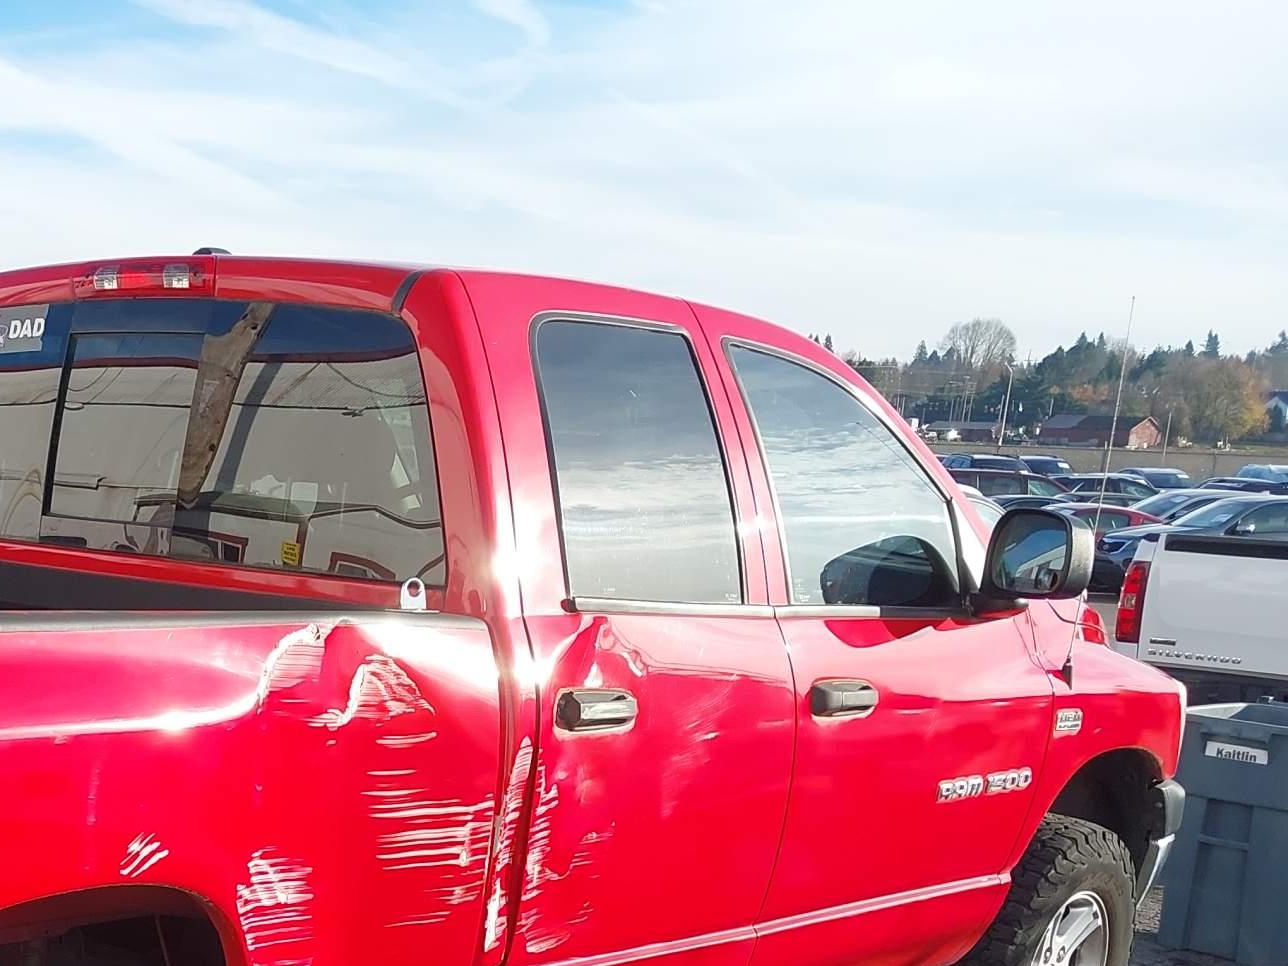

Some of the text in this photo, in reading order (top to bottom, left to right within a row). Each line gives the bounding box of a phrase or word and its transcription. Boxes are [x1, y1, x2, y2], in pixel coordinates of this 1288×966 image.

[8, 318, 45, 339] DAD
[1148, 648, 1242, 665] SILVERADO
[1216, 747, 1257, 763] Kaitlin
[938, 767, 1033, 801] RAM 1500
